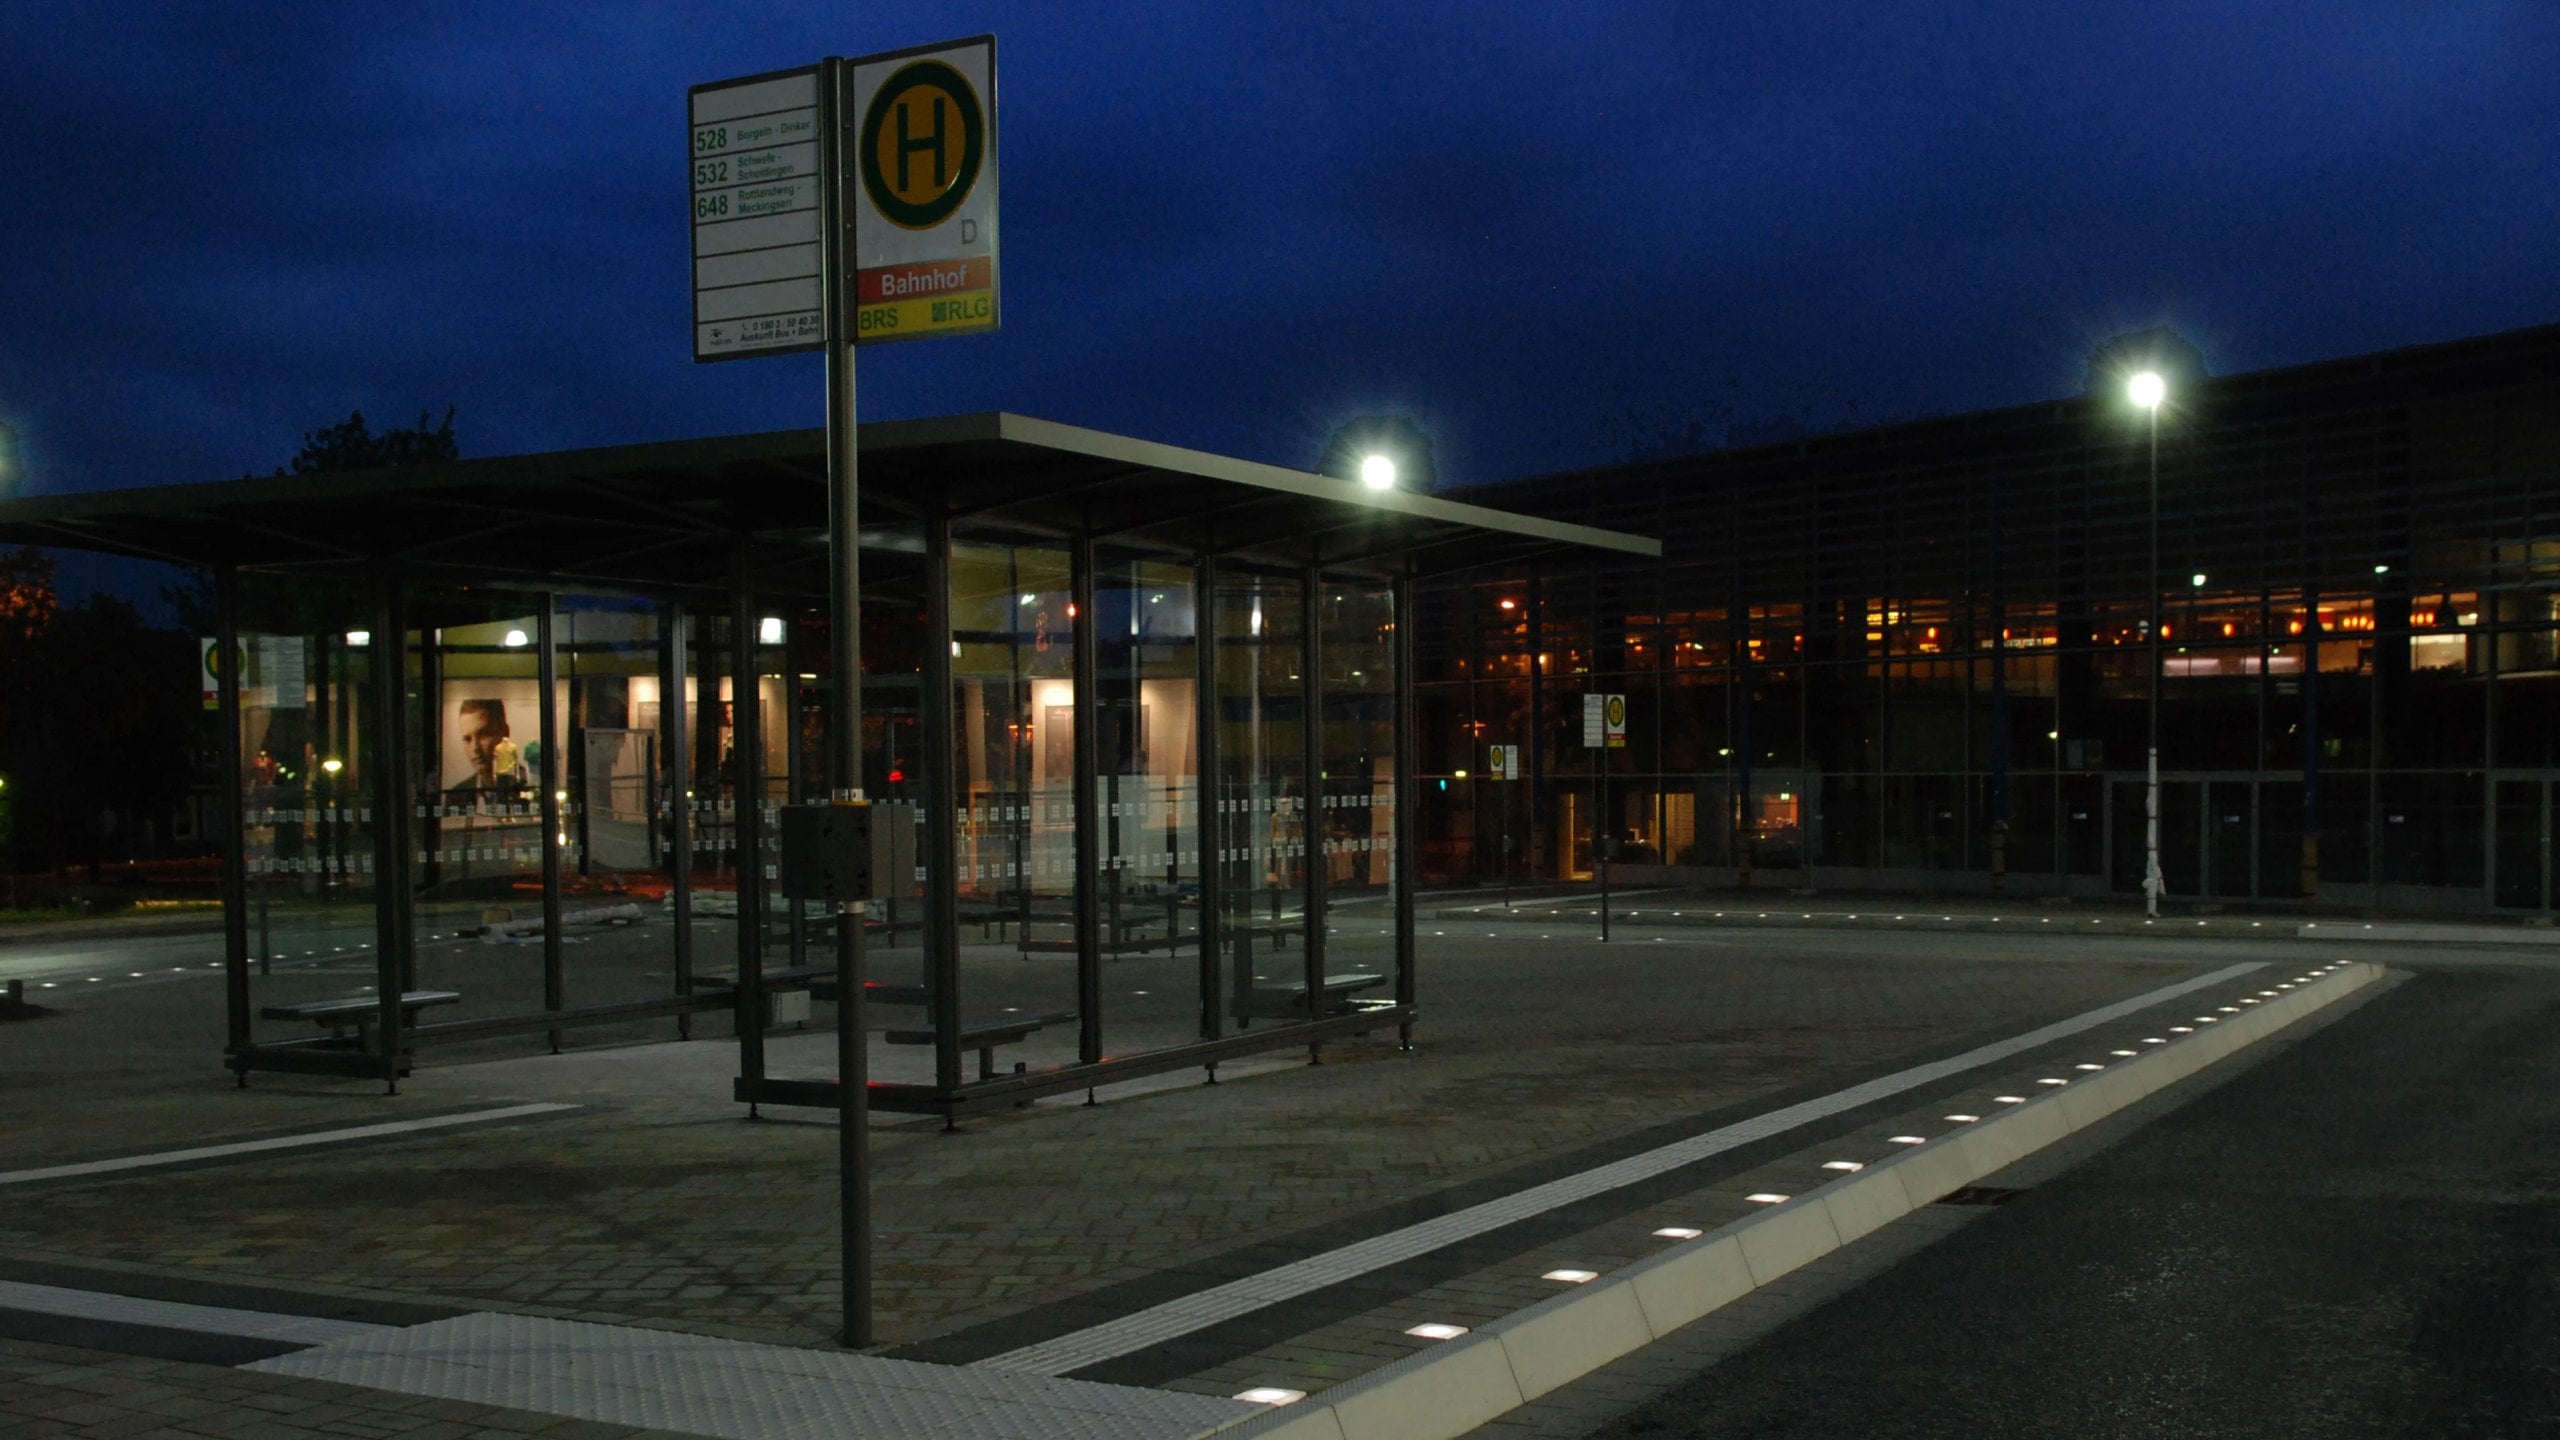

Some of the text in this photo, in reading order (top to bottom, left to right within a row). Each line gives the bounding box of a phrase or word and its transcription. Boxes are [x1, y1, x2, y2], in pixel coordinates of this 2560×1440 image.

[696, 128, 727, 151] 528
[896, 97, 945, 192] H
[697, 161, 728, 185] 532
[697, 195, 728, 218] 648
[961, 218, 977, 245] D
[881, 264, 968, 296] Bahnhof
[860, 307, 898, 331] BRS
[949, 296, 990, 320] RLG
[740, 331, 774, 342] Auskunft
